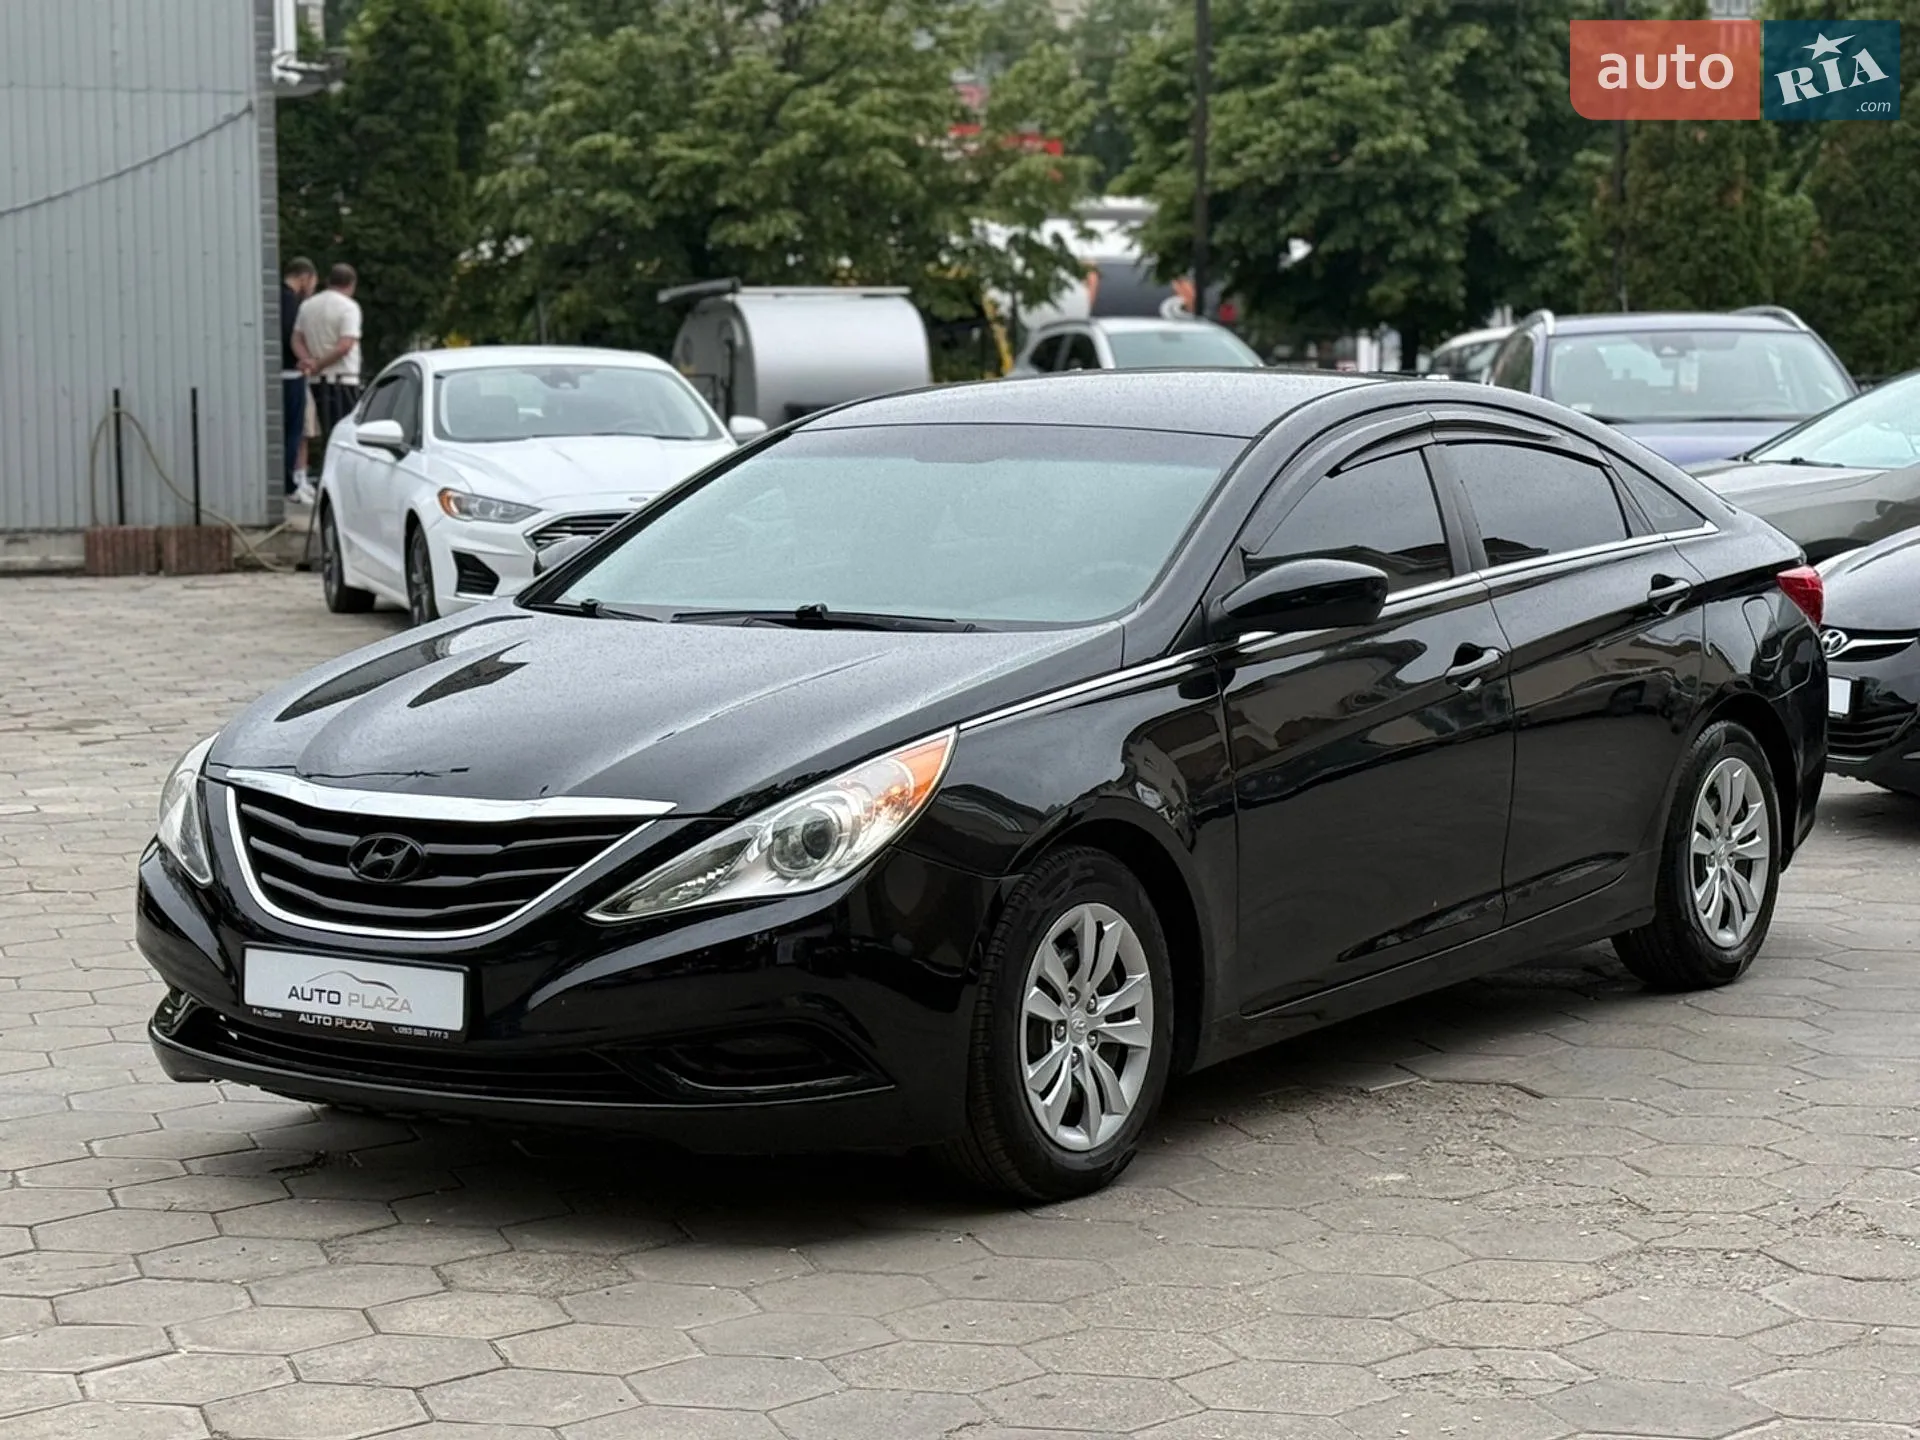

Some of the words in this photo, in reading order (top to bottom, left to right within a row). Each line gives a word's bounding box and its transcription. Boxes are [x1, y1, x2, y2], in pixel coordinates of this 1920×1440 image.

[288, 985, 342, 1006] AUTO
[347, 992, 413, 1014] PLAZA
[298, 1013, 333, 1027] AUTO
[334, 1017, 376, 1032] PLAZA
